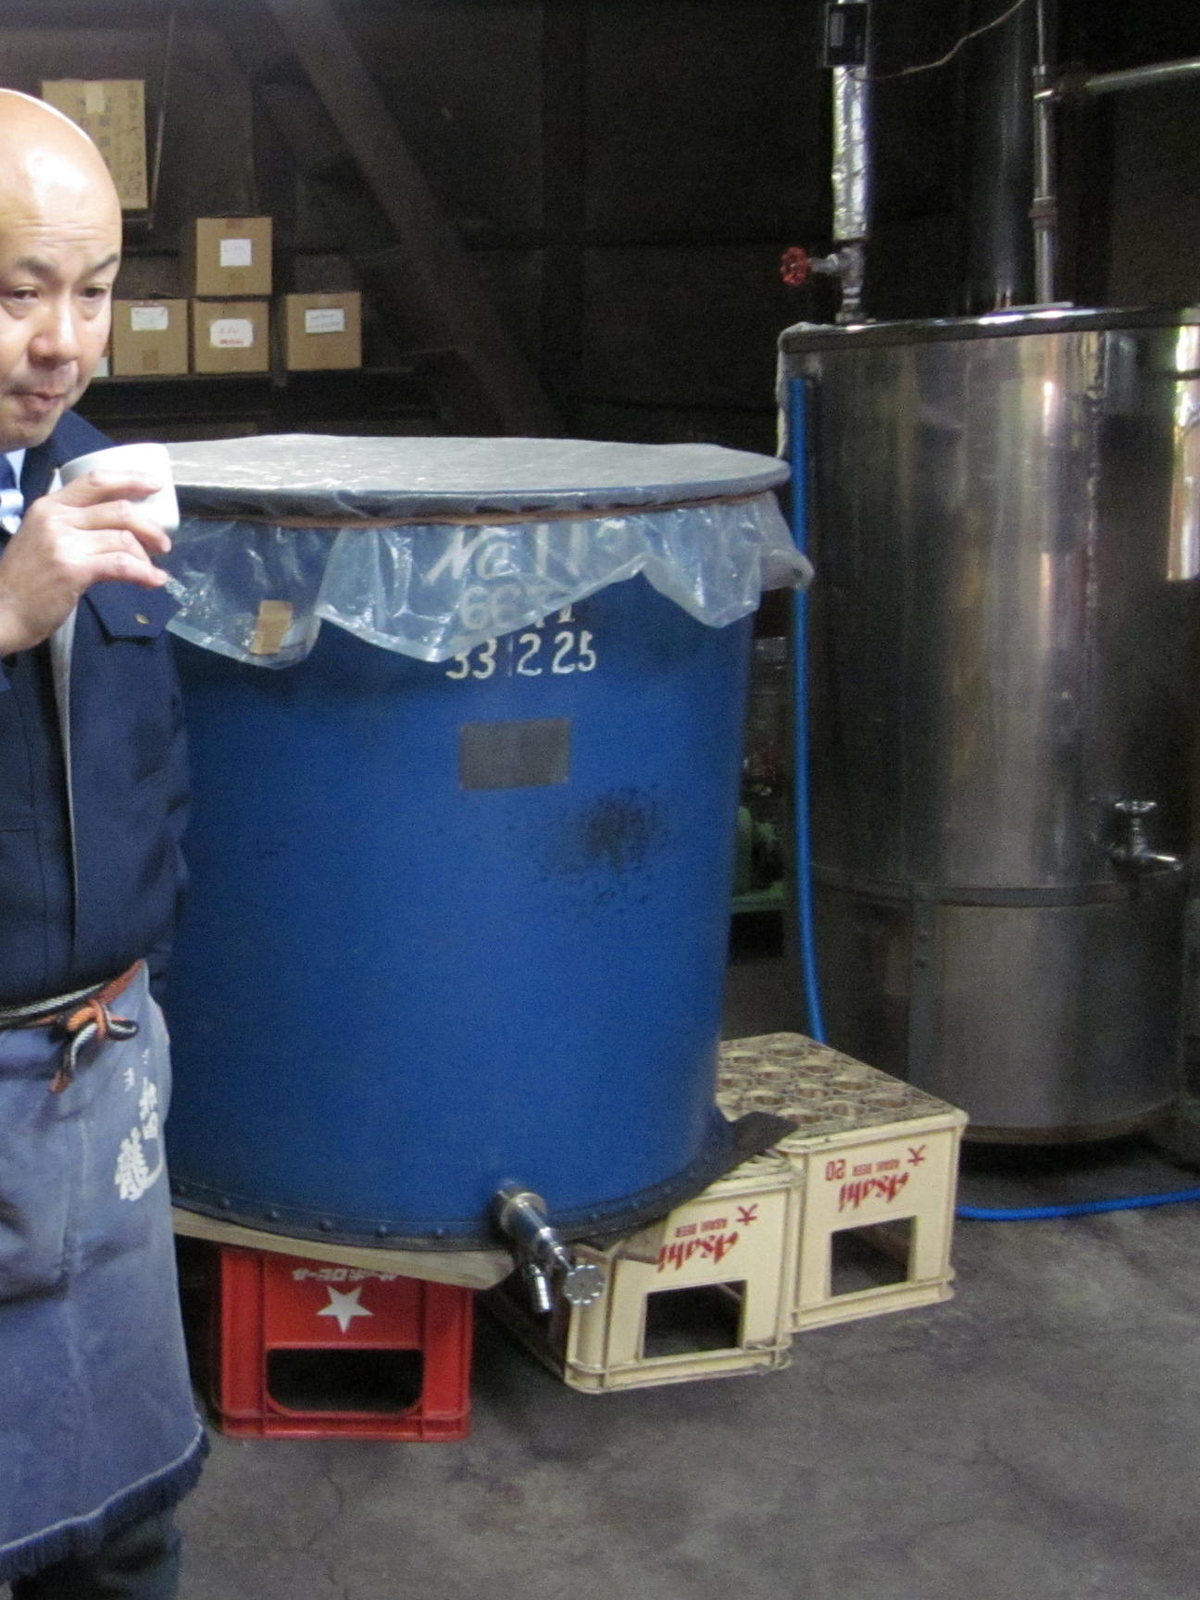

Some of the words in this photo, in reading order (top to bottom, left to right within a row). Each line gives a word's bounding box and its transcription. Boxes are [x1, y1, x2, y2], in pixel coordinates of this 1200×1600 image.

[825, 1158, 846, 1181] 20
[838, 1171, 909, 1213] Asahi
[657, 1231, 738, 1274] Asahi
